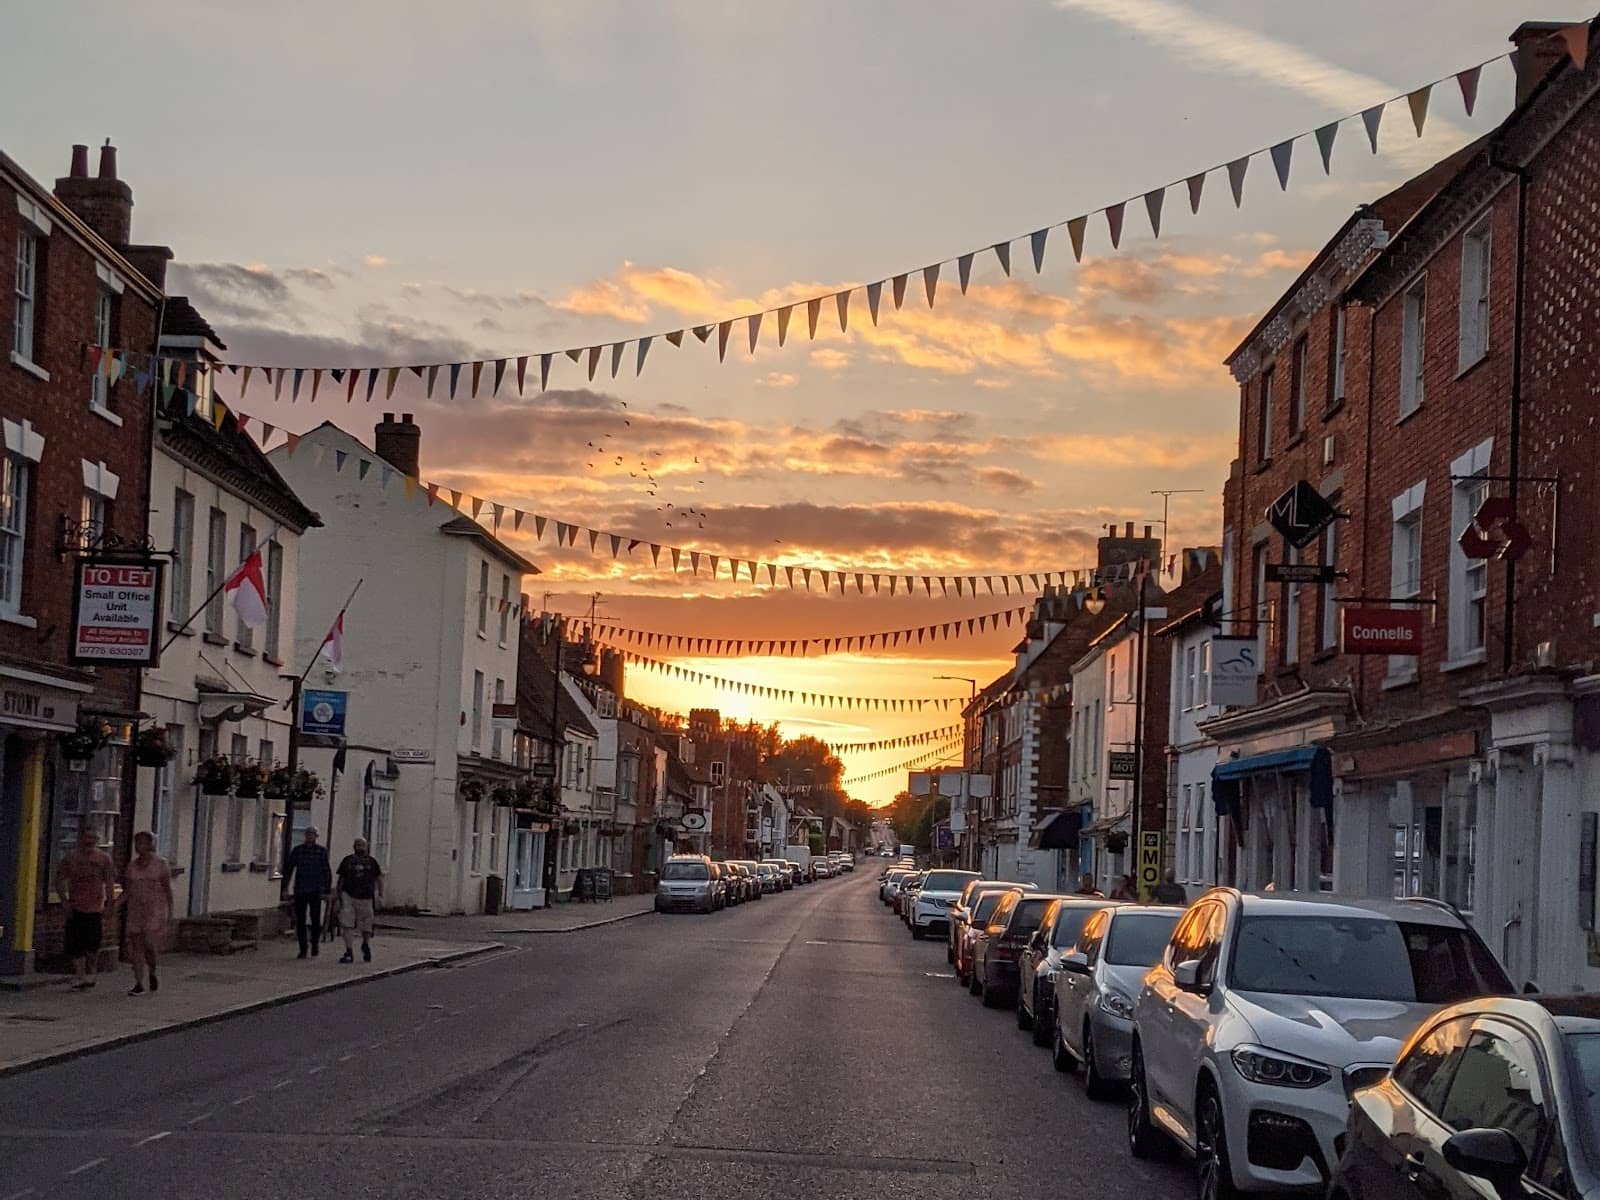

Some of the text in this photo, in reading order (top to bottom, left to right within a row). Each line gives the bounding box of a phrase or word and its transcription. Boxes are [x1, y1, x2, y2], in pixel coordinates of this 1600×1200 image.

[88, 569, 151, 586] TO LET
[85, 590, 150, 601] Small Office
[106, 602, 127, 611] Unit
[93, 612, 140, 623] Available
[1352, 625, 1414, 640] Connells
[4, 690, 40, 717] STONY
